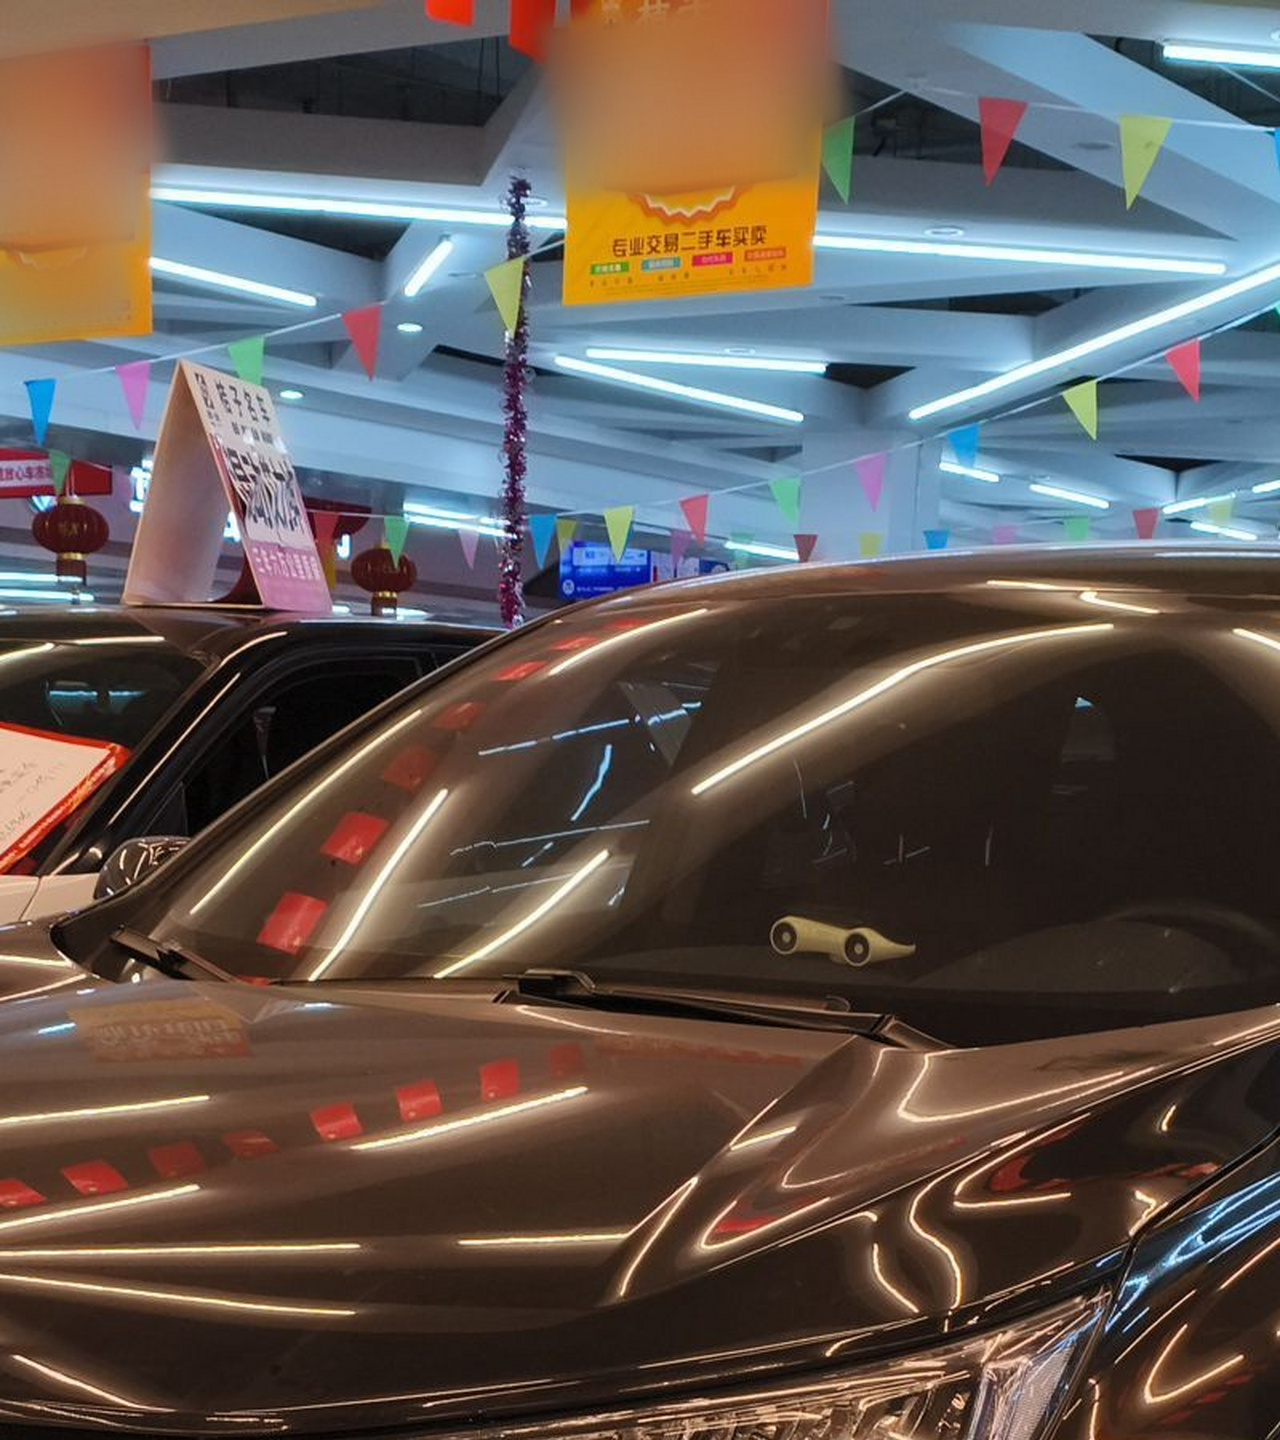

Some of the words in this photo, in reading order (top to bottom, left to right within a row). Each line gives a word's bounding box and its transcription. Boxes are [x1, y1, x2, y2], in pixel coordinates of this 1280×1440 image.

[612, 225, 768, 258] 专业交易二手车买卖
